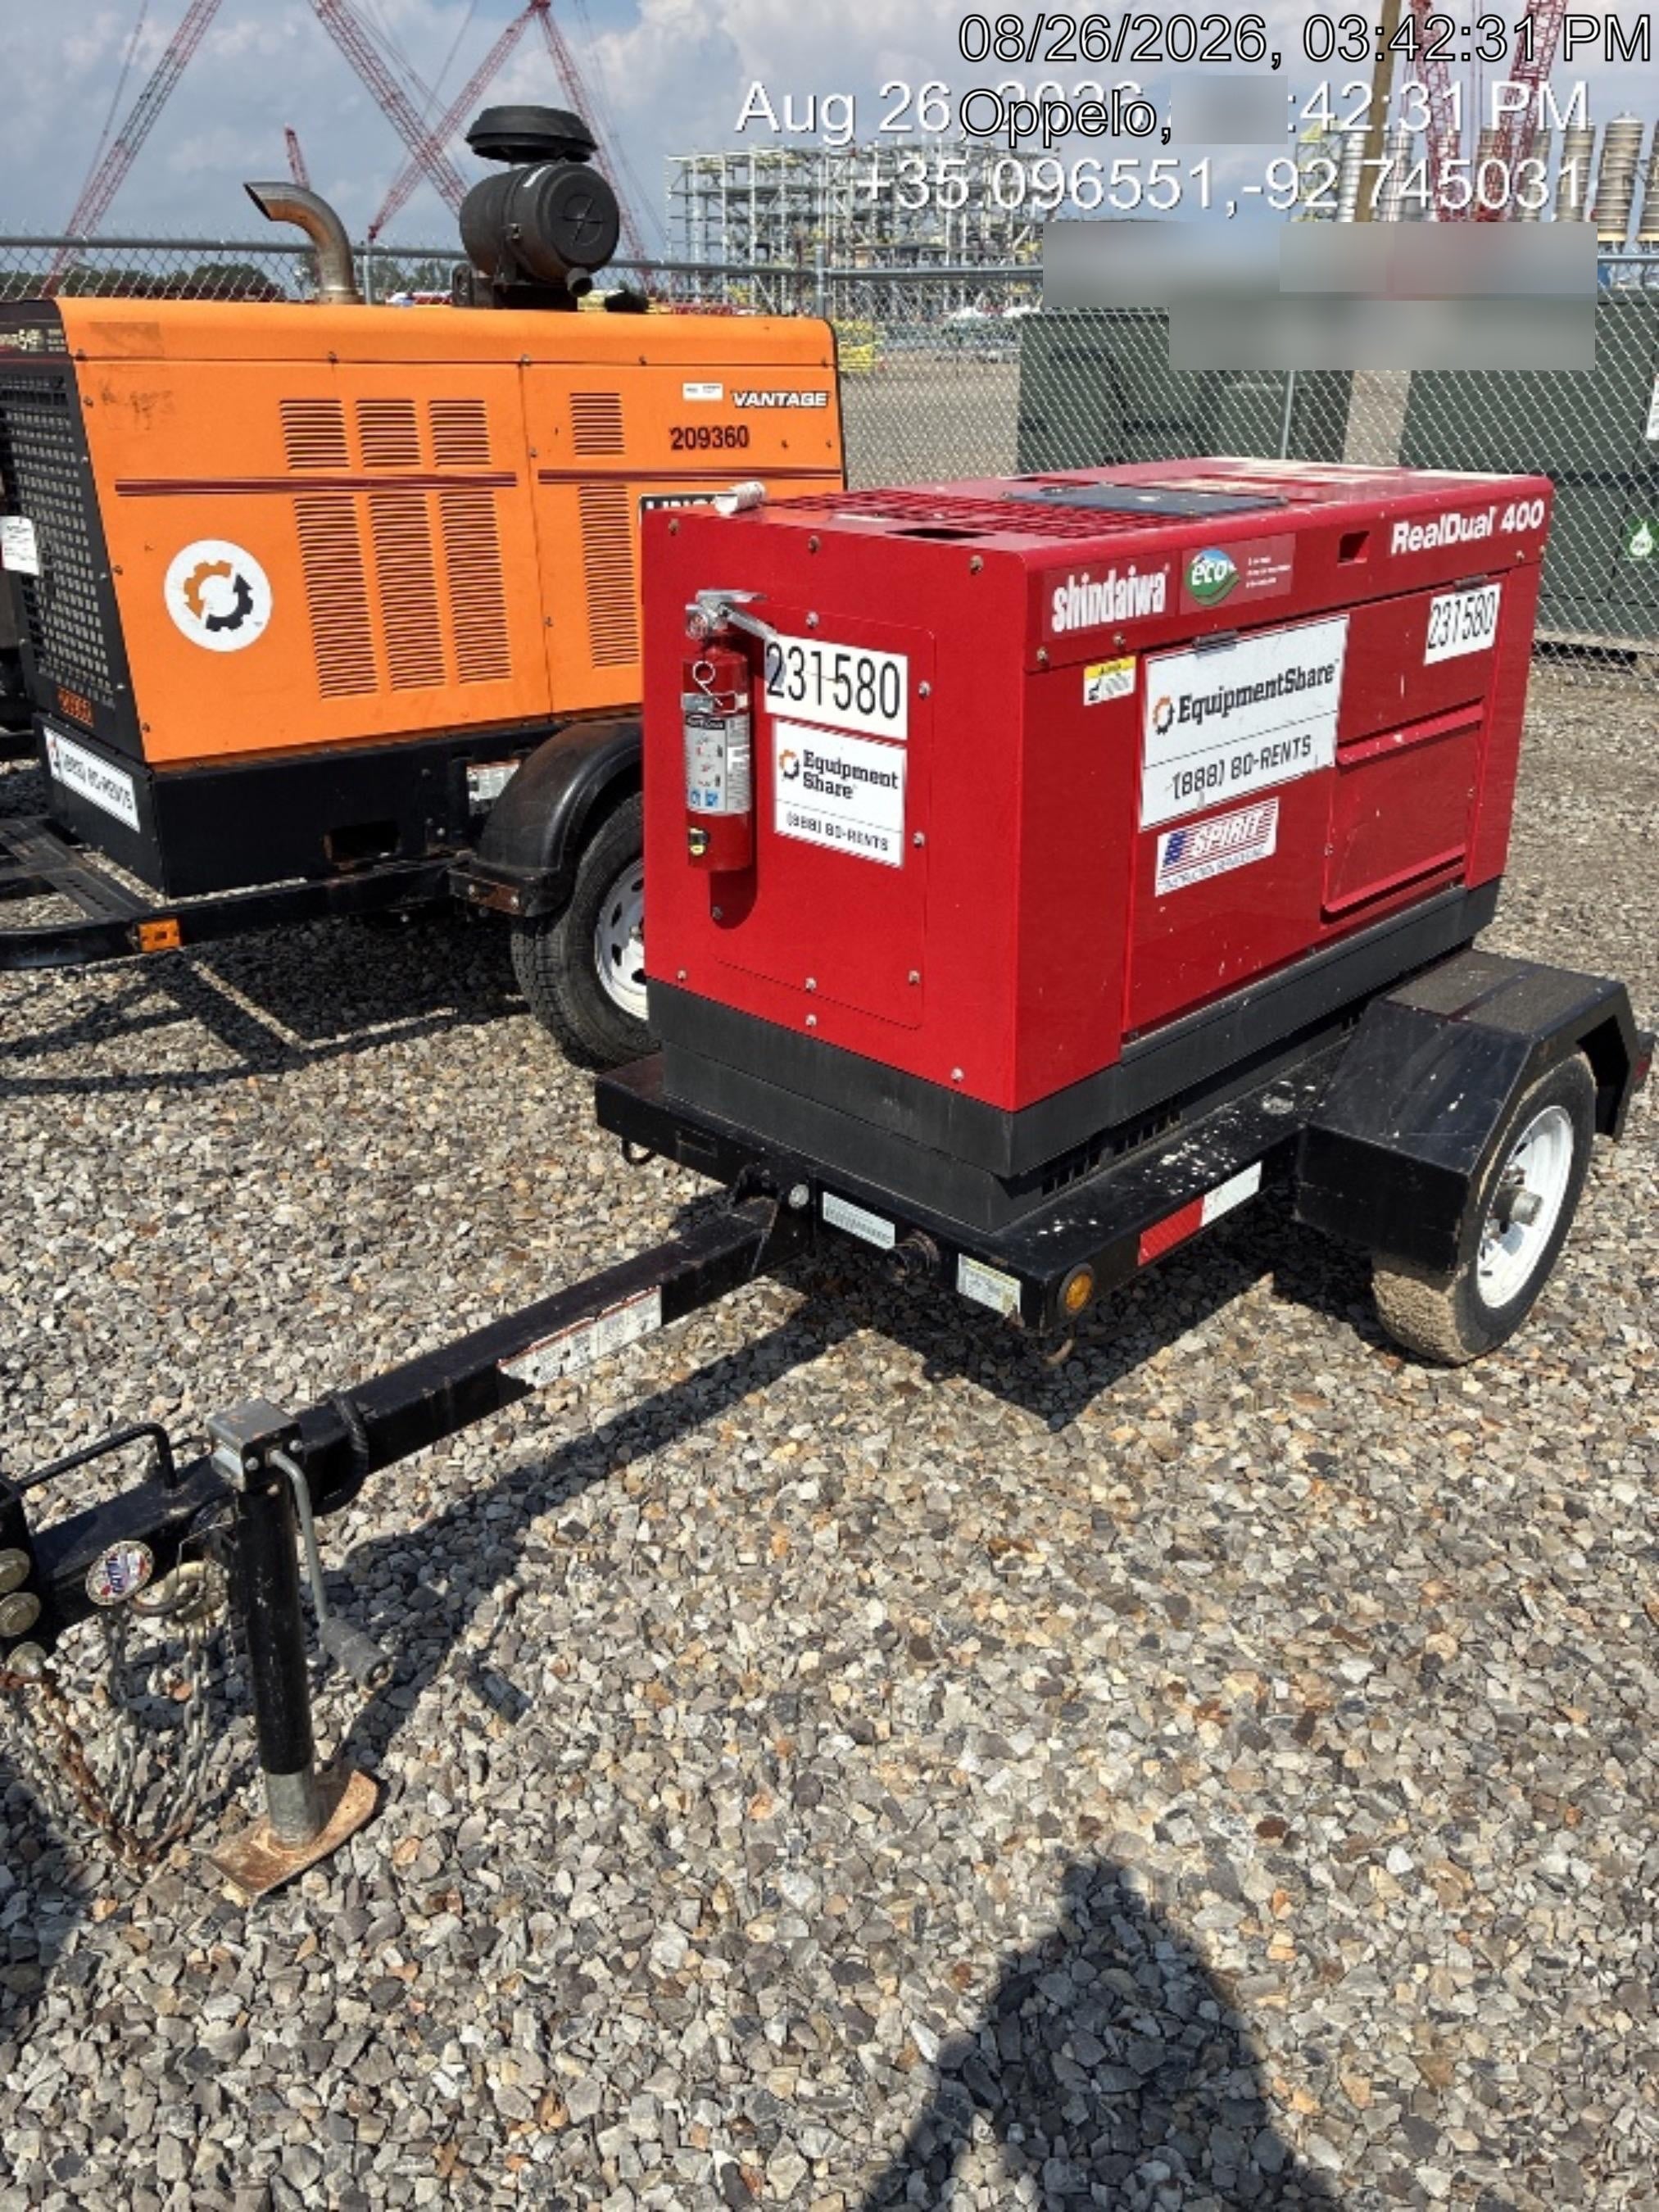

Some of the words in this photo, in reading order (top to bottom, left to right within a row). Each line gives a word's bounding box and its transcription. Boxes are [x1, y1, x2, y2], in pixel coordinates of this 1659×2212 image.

[732, 392, 829, 408] VANTAGE
[669, 425, 750, 451] 209360
[1391, 505, 1497, 555] RealDual
[1500, 499, 1545, 533] 400
[1191, 560, 1229, 586] eco
[1051, 564, 1167, 632] shindaiwa
[1428, 592, 1496, 650] 231580
[766, 641, 901, 718] 231580
[1177, 662, 1337, 726] EquipmentShare
[803, 749, 900, 790] Equipment
[803, 771, 854, 800] Share
[1172, 759, 1226, 800] (888)
[1231, 734, 1312, 781] 80-RENTS
[786, 811, 822, 834] (888)
[1192, 809, 1266, 857] SPIRIT
